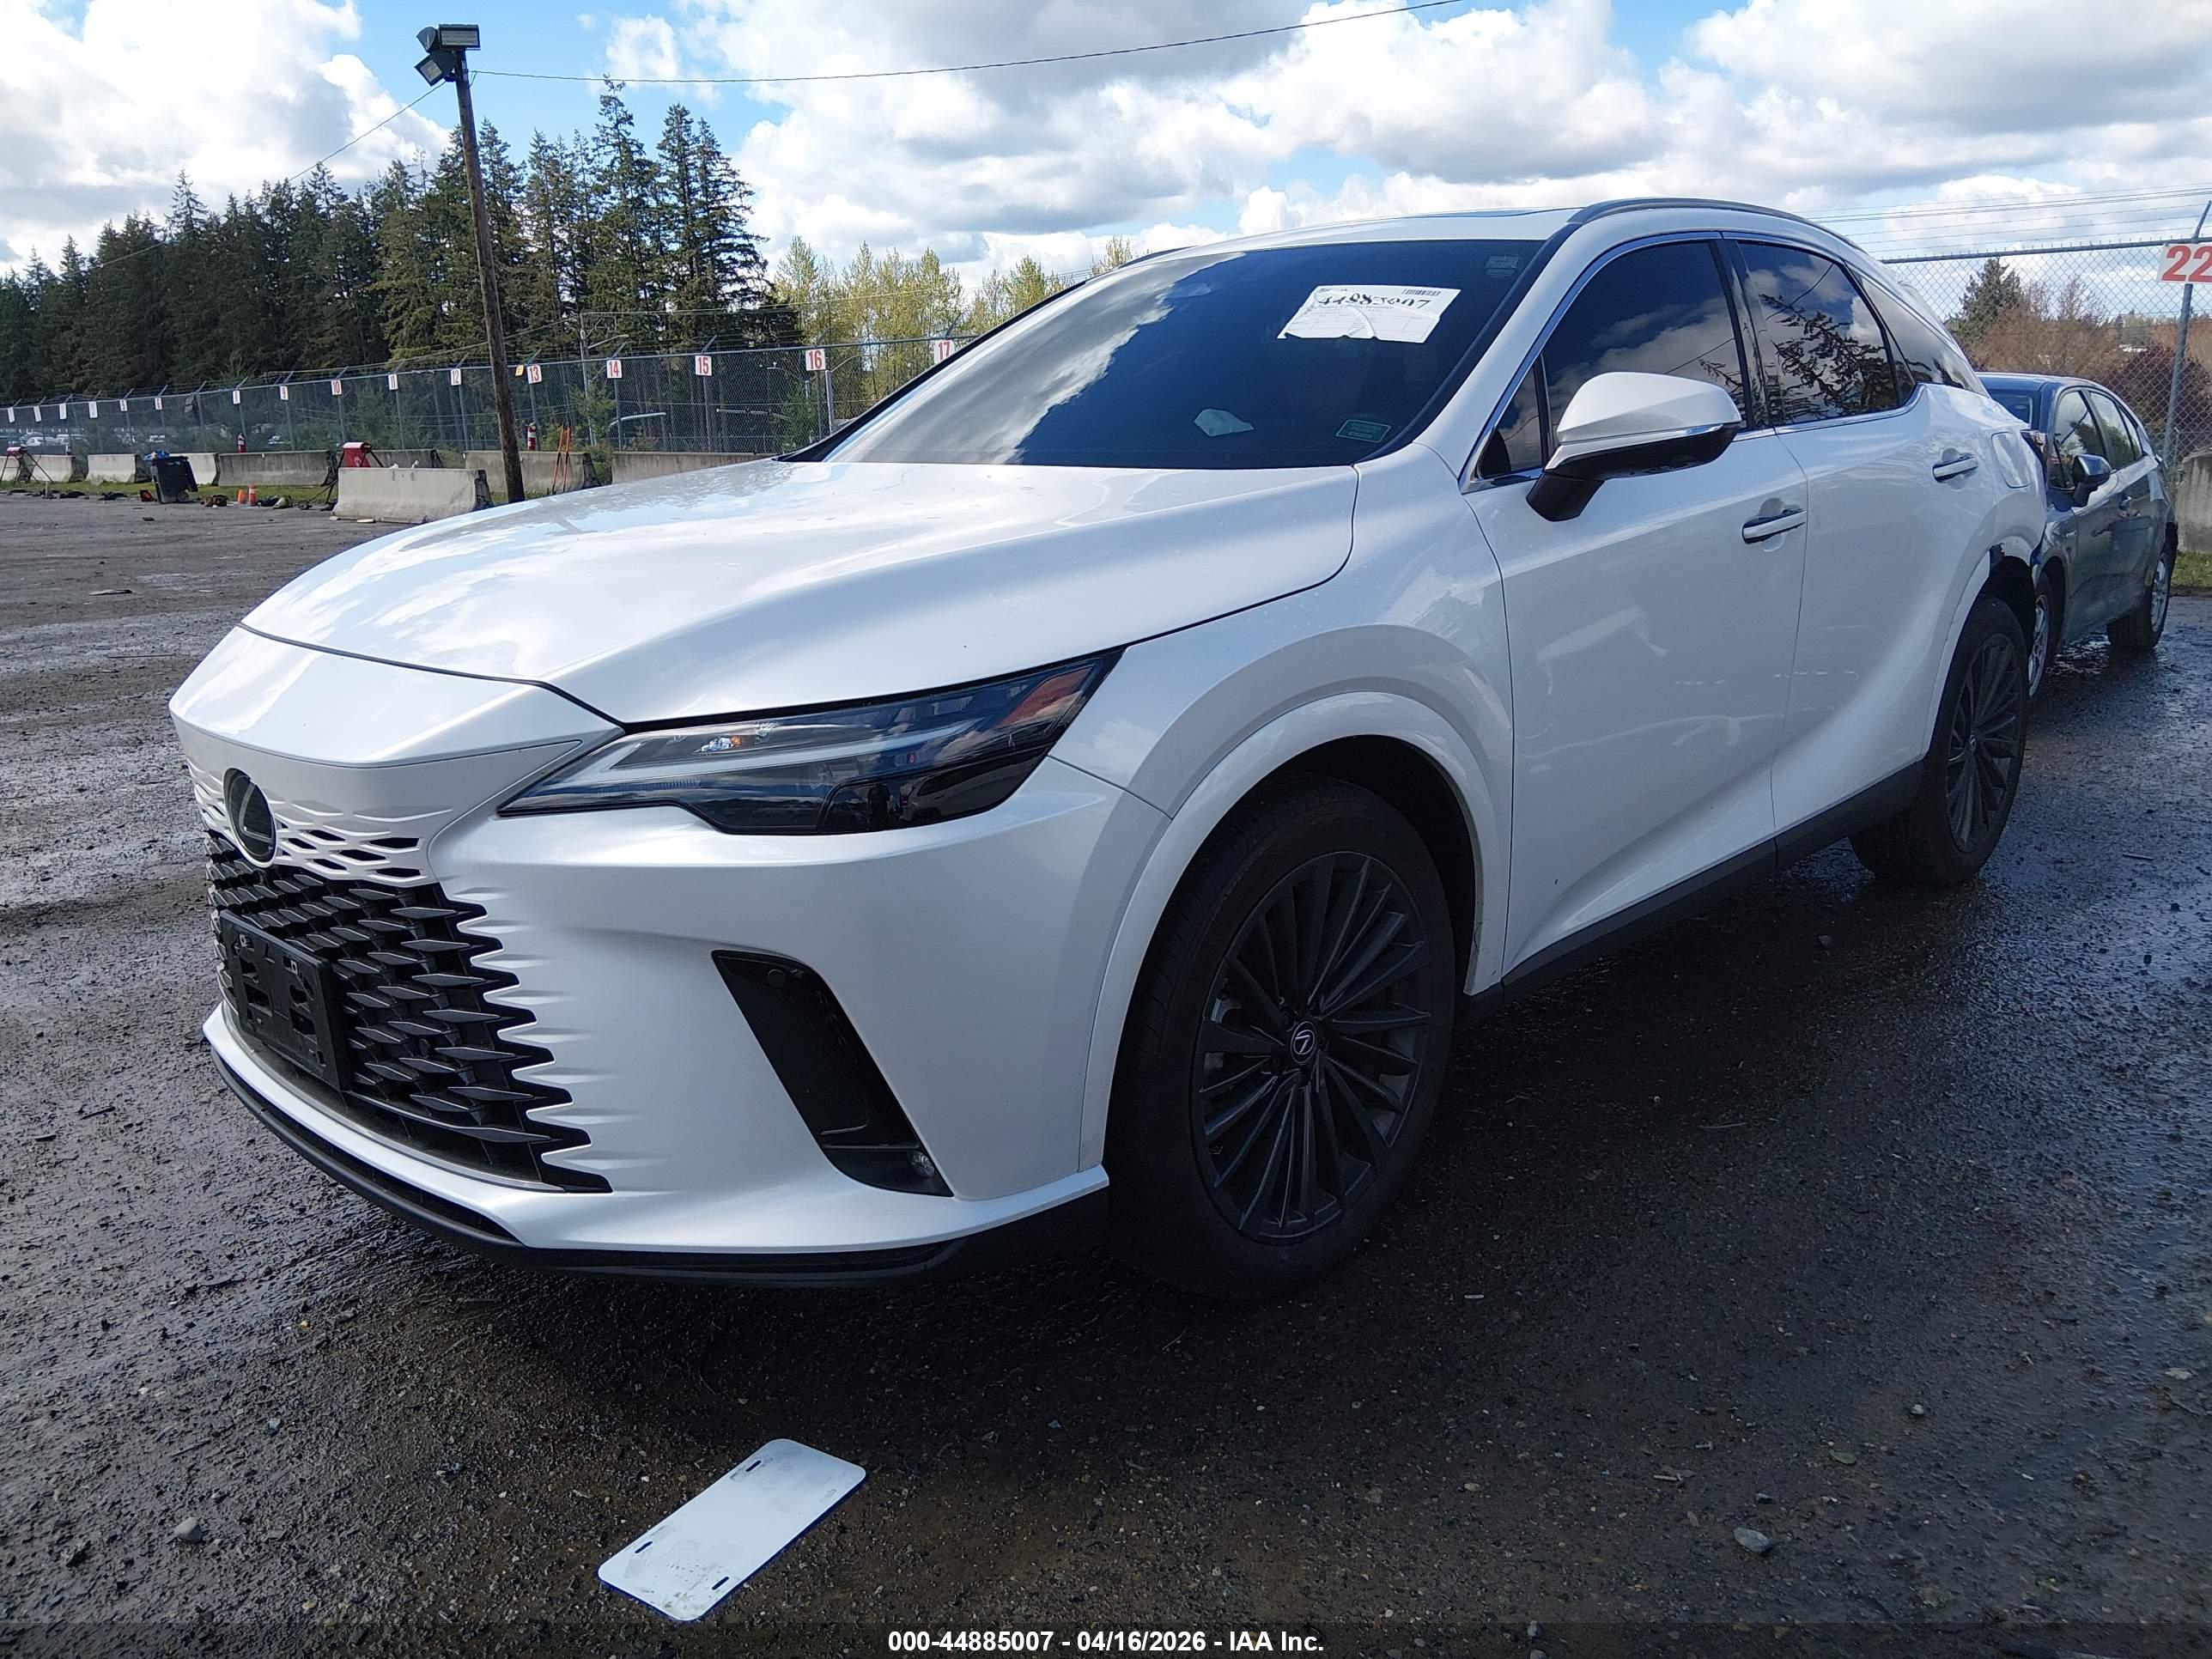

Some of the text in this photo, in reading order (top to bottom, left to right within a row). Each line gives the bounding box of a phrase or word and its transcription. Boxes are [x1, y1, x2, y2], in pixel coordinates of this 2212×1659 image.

[2161, 245, 2212, 282] 22
[938, 341, 951, 361] 17
[697, 356, 709, 374] 15
[808, 350, 823, 369] 16
[452, 369, 460, 385] 12
[529, 366, 539, 382] 13
[609, 361, 619, 377] 14
[332, 380, 341, 394] 10
[390, 375, 396, 389] 11
